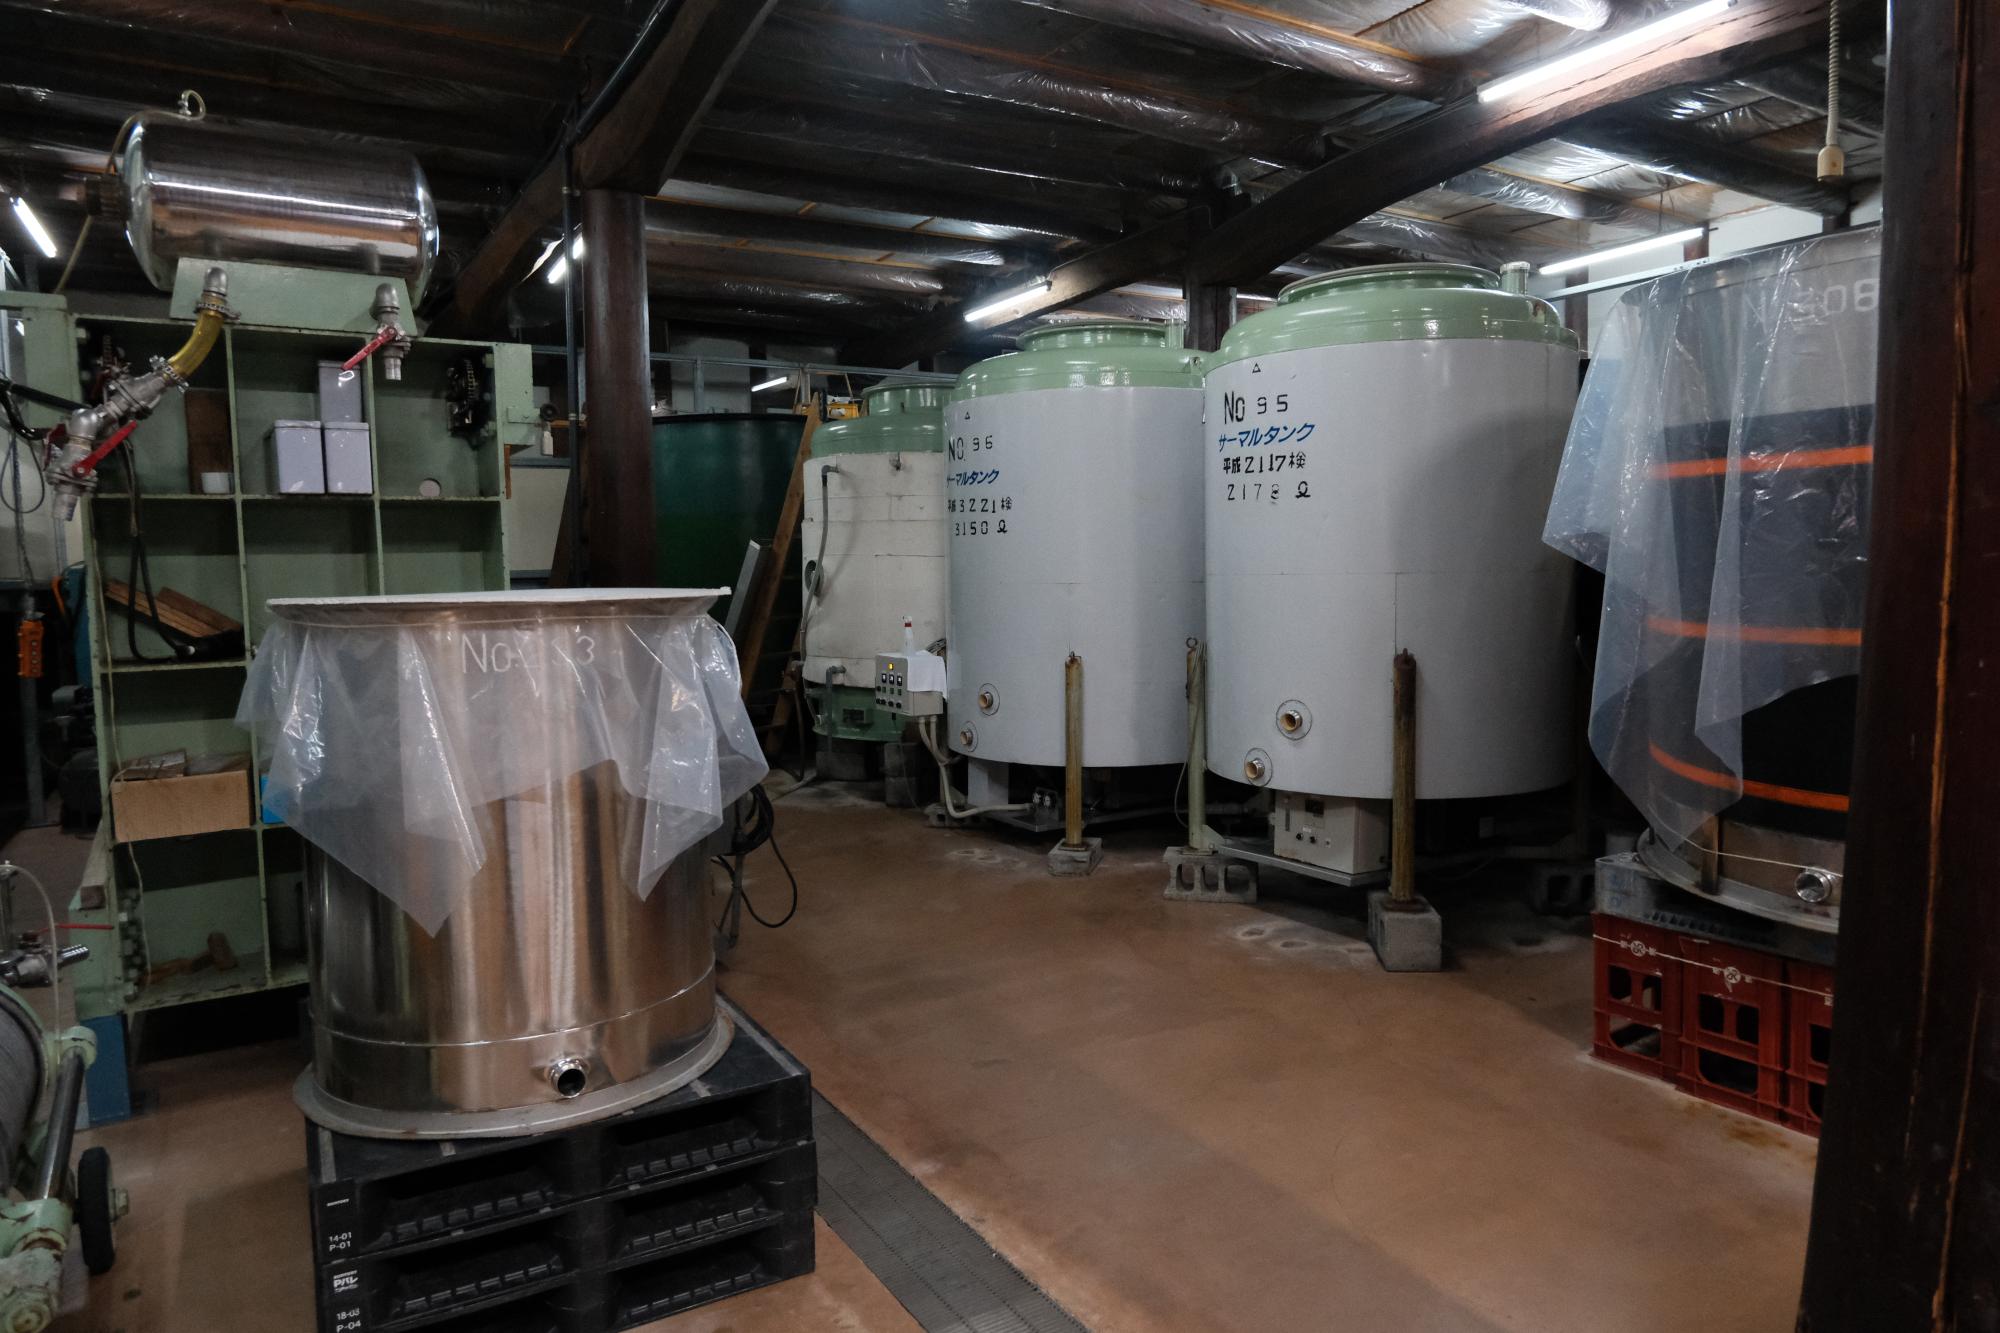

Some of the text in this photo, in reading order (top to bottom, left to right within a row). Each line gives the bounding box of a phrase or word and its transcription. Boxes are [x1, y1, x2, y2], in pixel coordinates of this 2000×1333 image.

[1257, 393, 1289, 415] 95
[973, 435, 994, 451] 96
[1219, 423, 1316, 452] サーマルタンク
[955, 521, 989, 536] 3150
[329, 1241, 351, 1252] P-01
